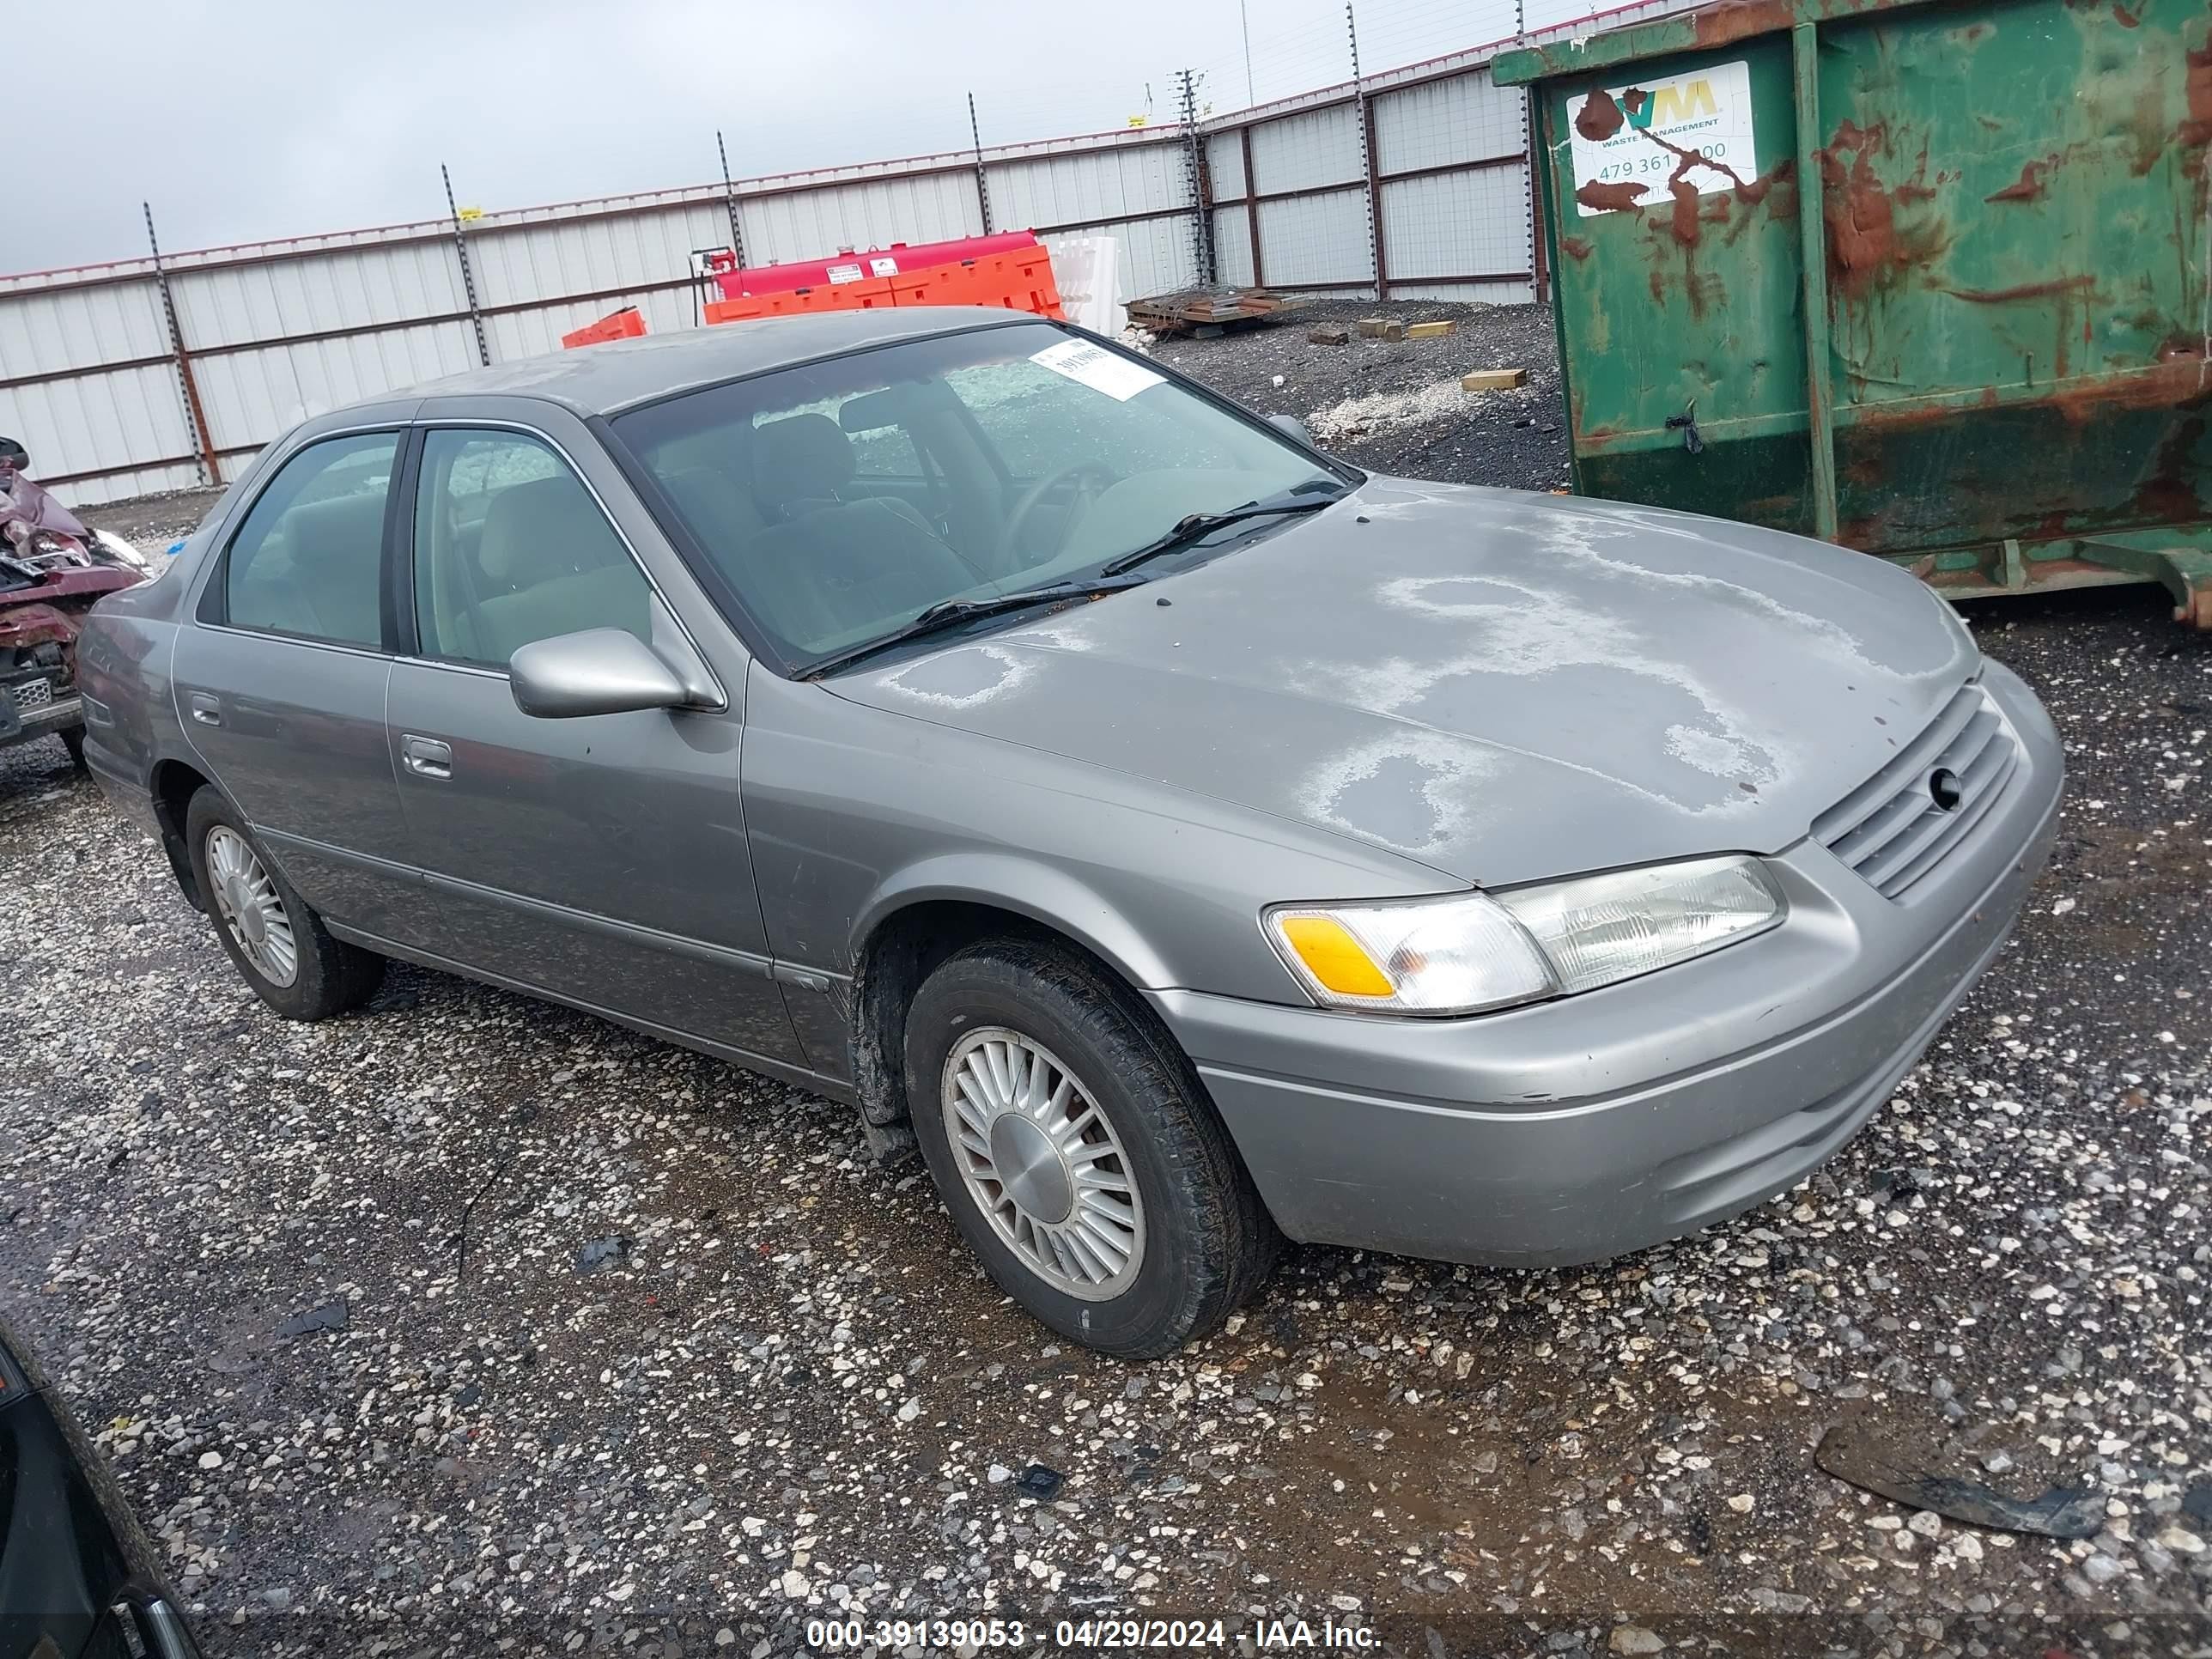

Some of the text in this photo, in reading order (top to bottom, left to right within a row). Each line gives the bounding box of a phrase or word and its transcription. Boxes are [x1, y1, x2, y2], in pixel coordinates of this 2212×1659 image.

[1601, 118, 1719, 149] WASTE MANAGEMENT
[1600, 161, 1632, 180] 479
[1638, 154, 1671, 173] 361
